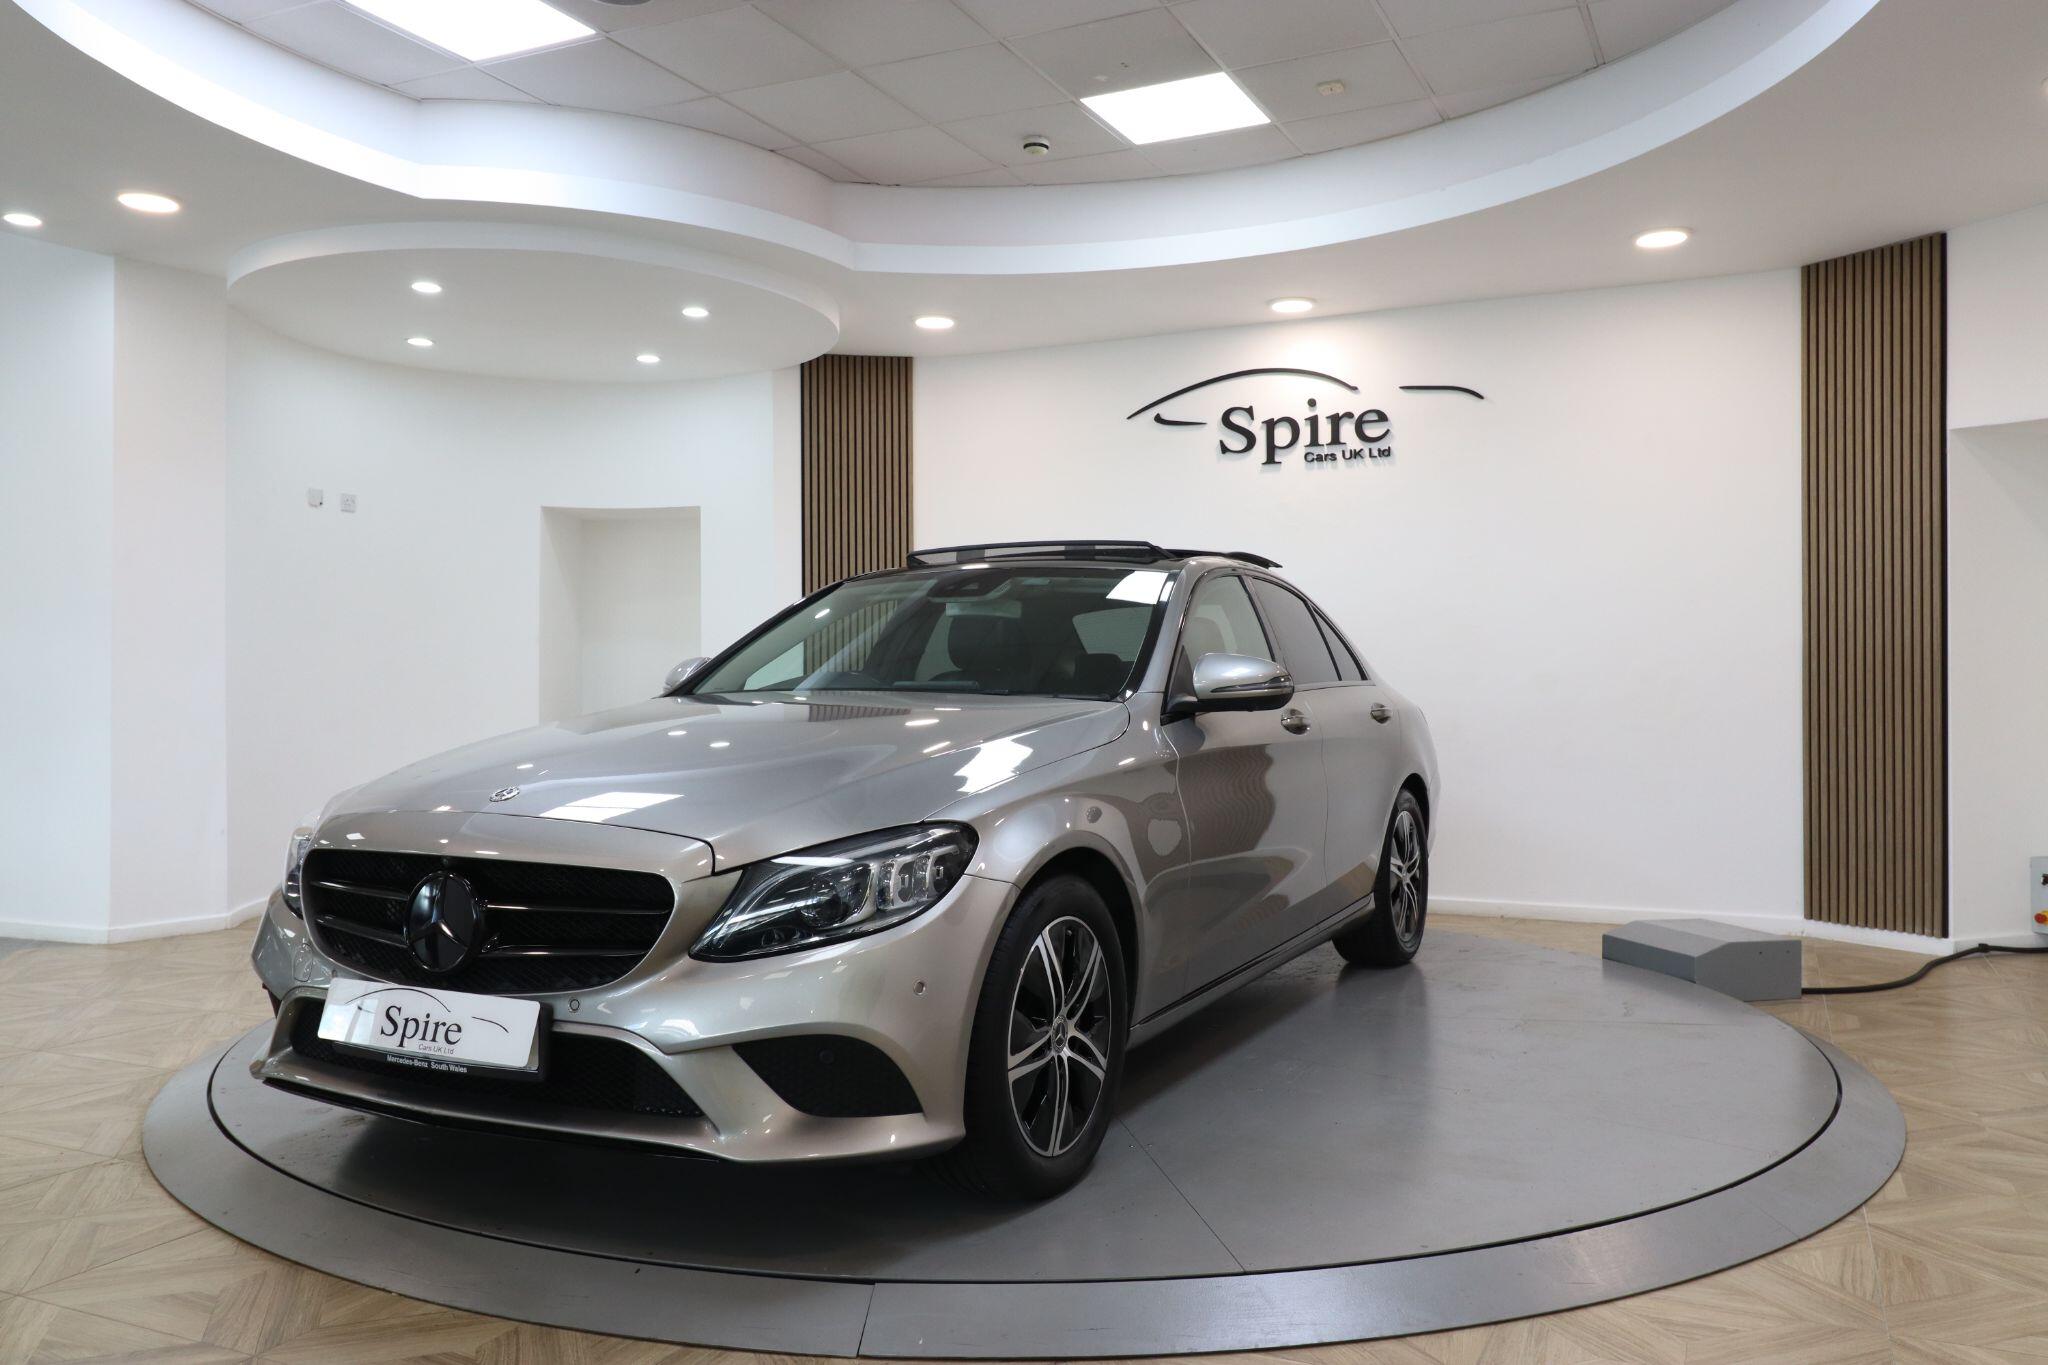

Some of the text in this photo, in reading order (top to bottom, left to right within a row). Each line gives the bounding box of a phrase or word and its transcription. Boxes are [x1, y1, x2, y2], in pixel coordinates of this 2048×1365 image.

[1219, 398, 1390, 465] Spire
[1304, 446, 1391, 464] Cars UK Ltd
[380, 1005, 462, 1048] Spire
[418, 1043, 455, 1055] Cars UK Ltd
[387, 1054, 467, 1073] Mercedes-Benz South Wales
